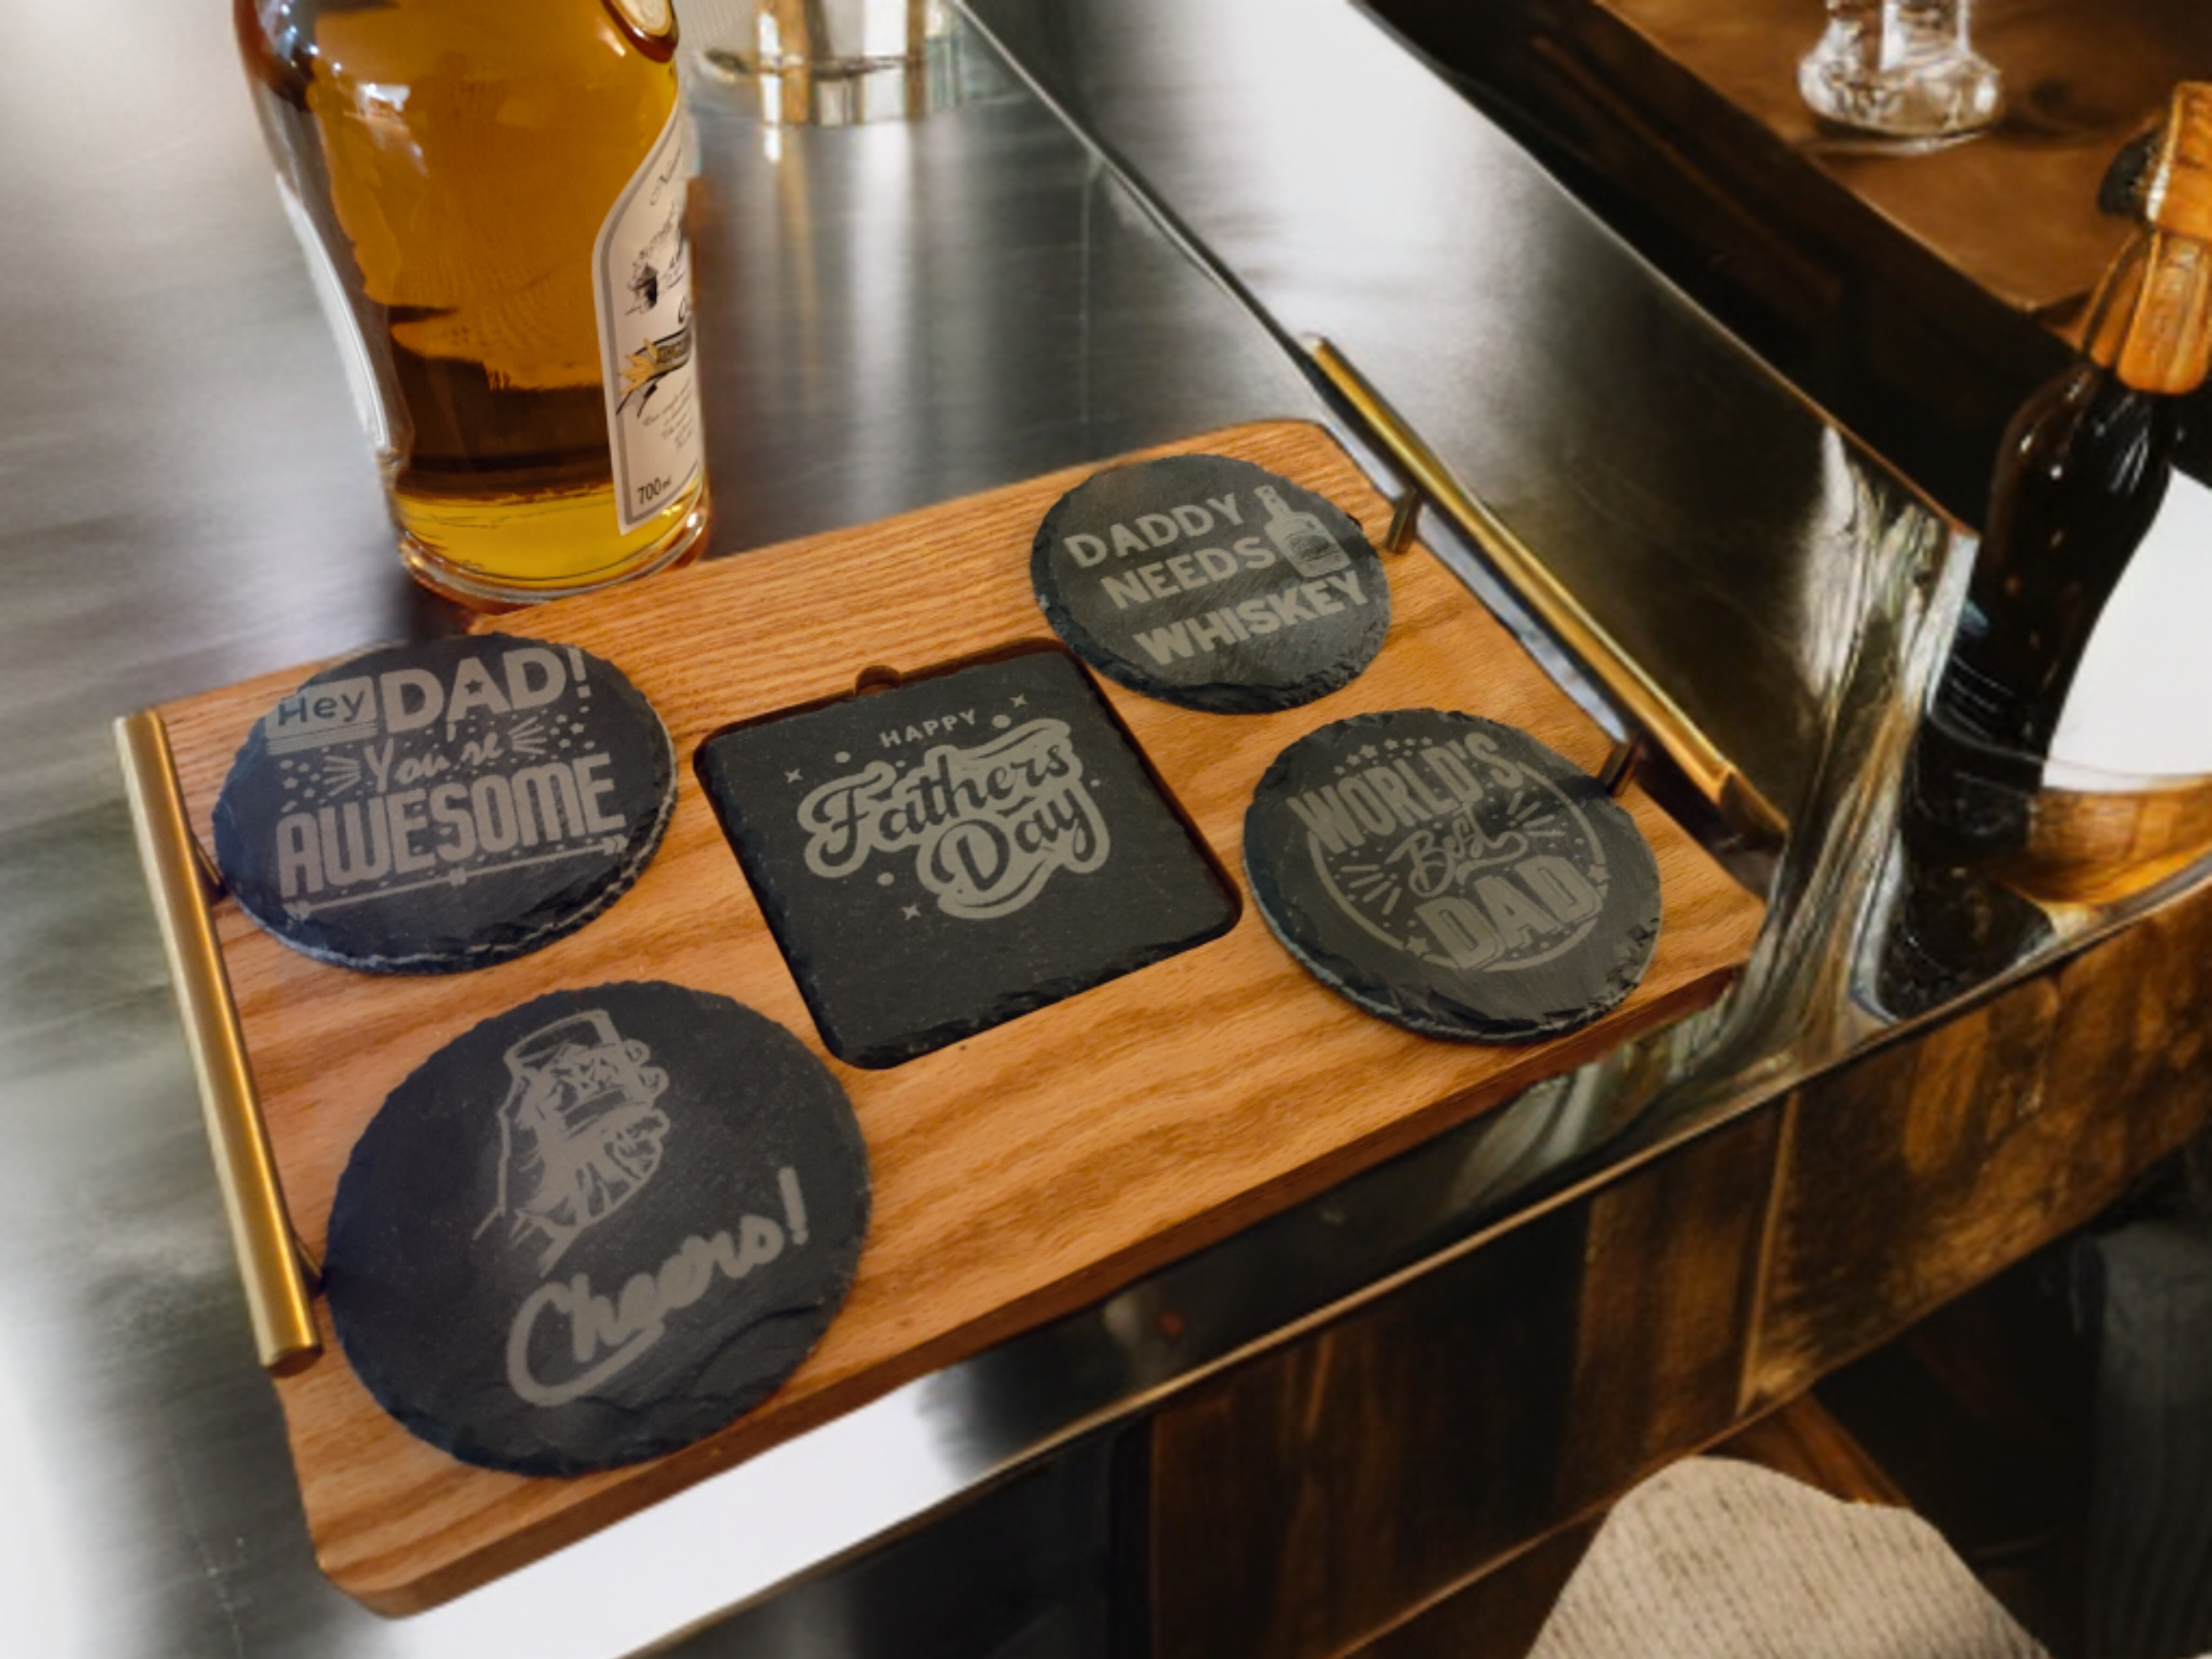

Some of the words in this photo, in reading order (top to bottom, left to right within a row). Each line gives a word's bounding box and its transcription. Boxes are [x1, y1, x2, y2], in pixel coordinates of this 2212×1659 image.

[1063, 493, 1244, 568] DADDY
[1100, 536, 1275, 609] NEEDS
[1134, 570, 1369, 665] WHISKEY
[276, 687, 366, 726] Hey
[380, 646, 591, 734] DAD!
[879, 708, 977, 748] HAPPY
[275, 753, 626, 898] AWESOME
[811, 726, 1070, 867] Fathers
[1286, 732, 1523, 854] WORLD'S
[930, 788, 1097, 908] Day
[1384, 803, 1528, 897] Best
[1413, 855, 1605, 970] DAD
[506, 1166, 808, 1407] Cheers!
